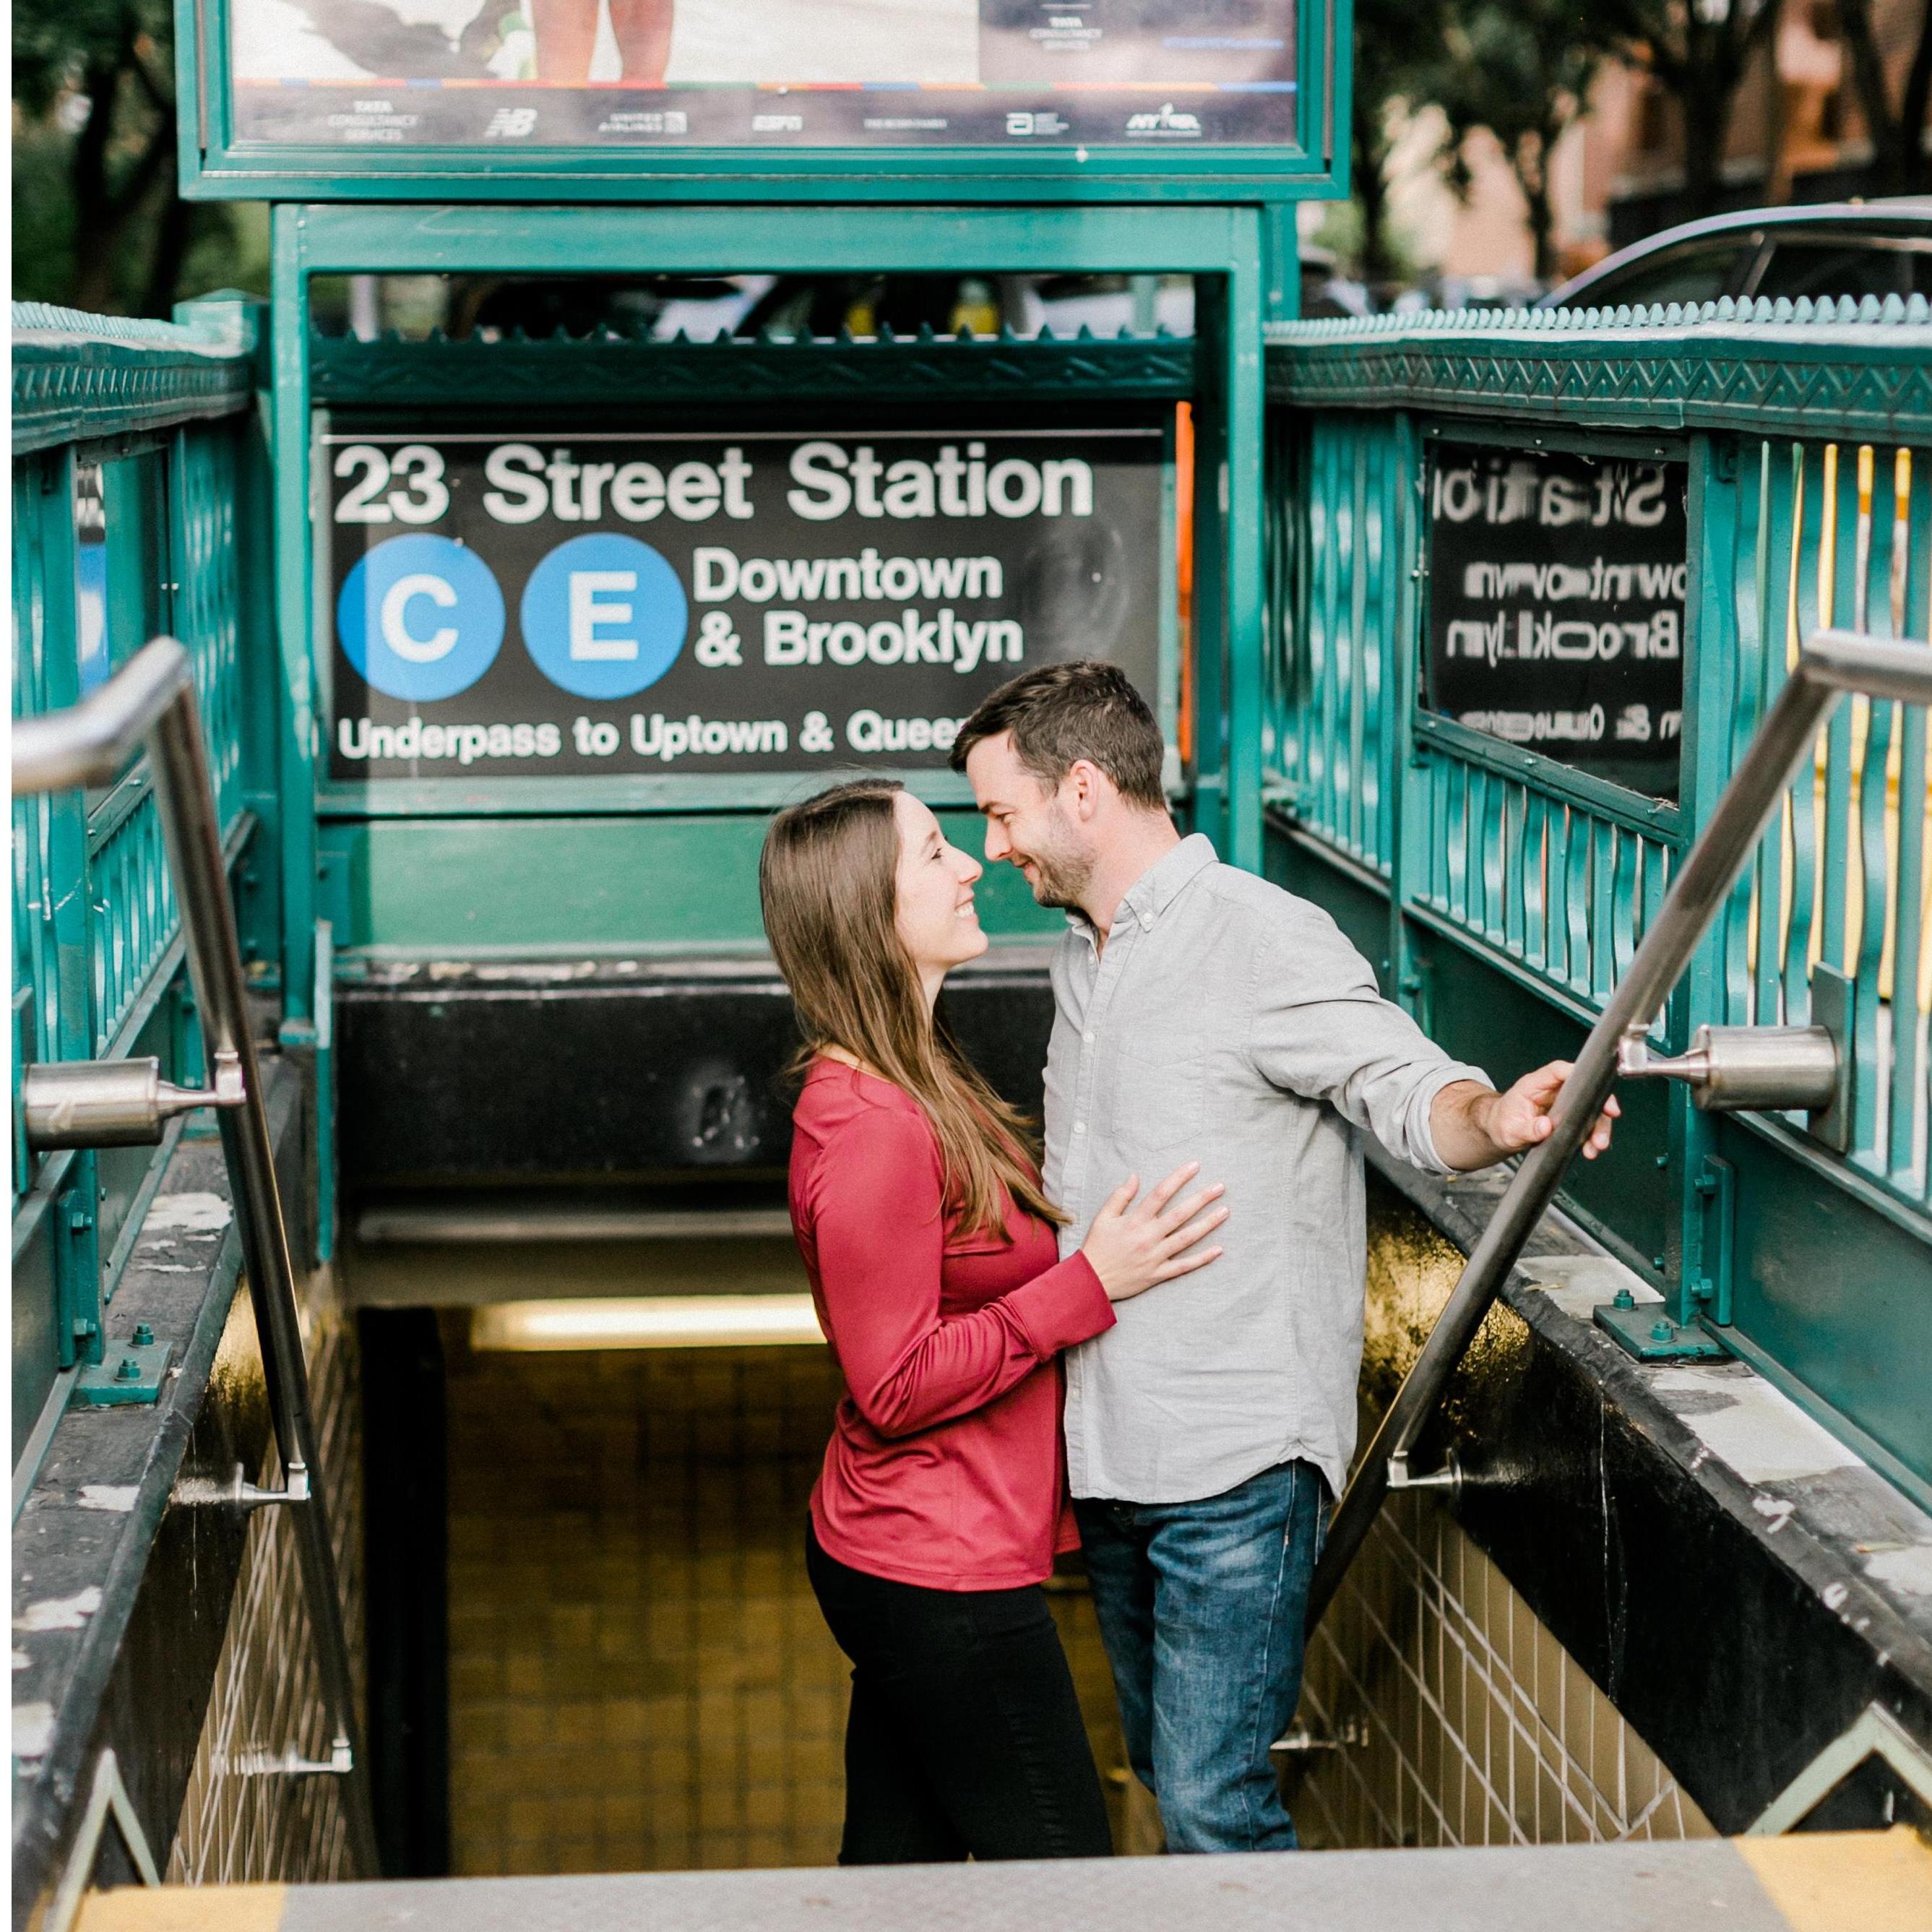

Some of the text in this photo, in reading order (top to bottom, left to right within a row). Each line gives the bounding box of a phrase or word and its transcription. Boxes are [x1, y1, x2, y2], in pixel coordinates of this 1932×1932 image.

[335, 442, 1094, 525] 23 Street Station
[693, 547, 1002, 603] Downtown
[381, 574, 458, 663] C
[569, 572, 639, 661] E
[694, 608, 1023, 673] & Brooklyn
[339, 716, 561, 765] Underpass
[572, 716, 620, 756] to
[630, 713, 788, 762] Uptown
[799, 711, 834, 752] &
